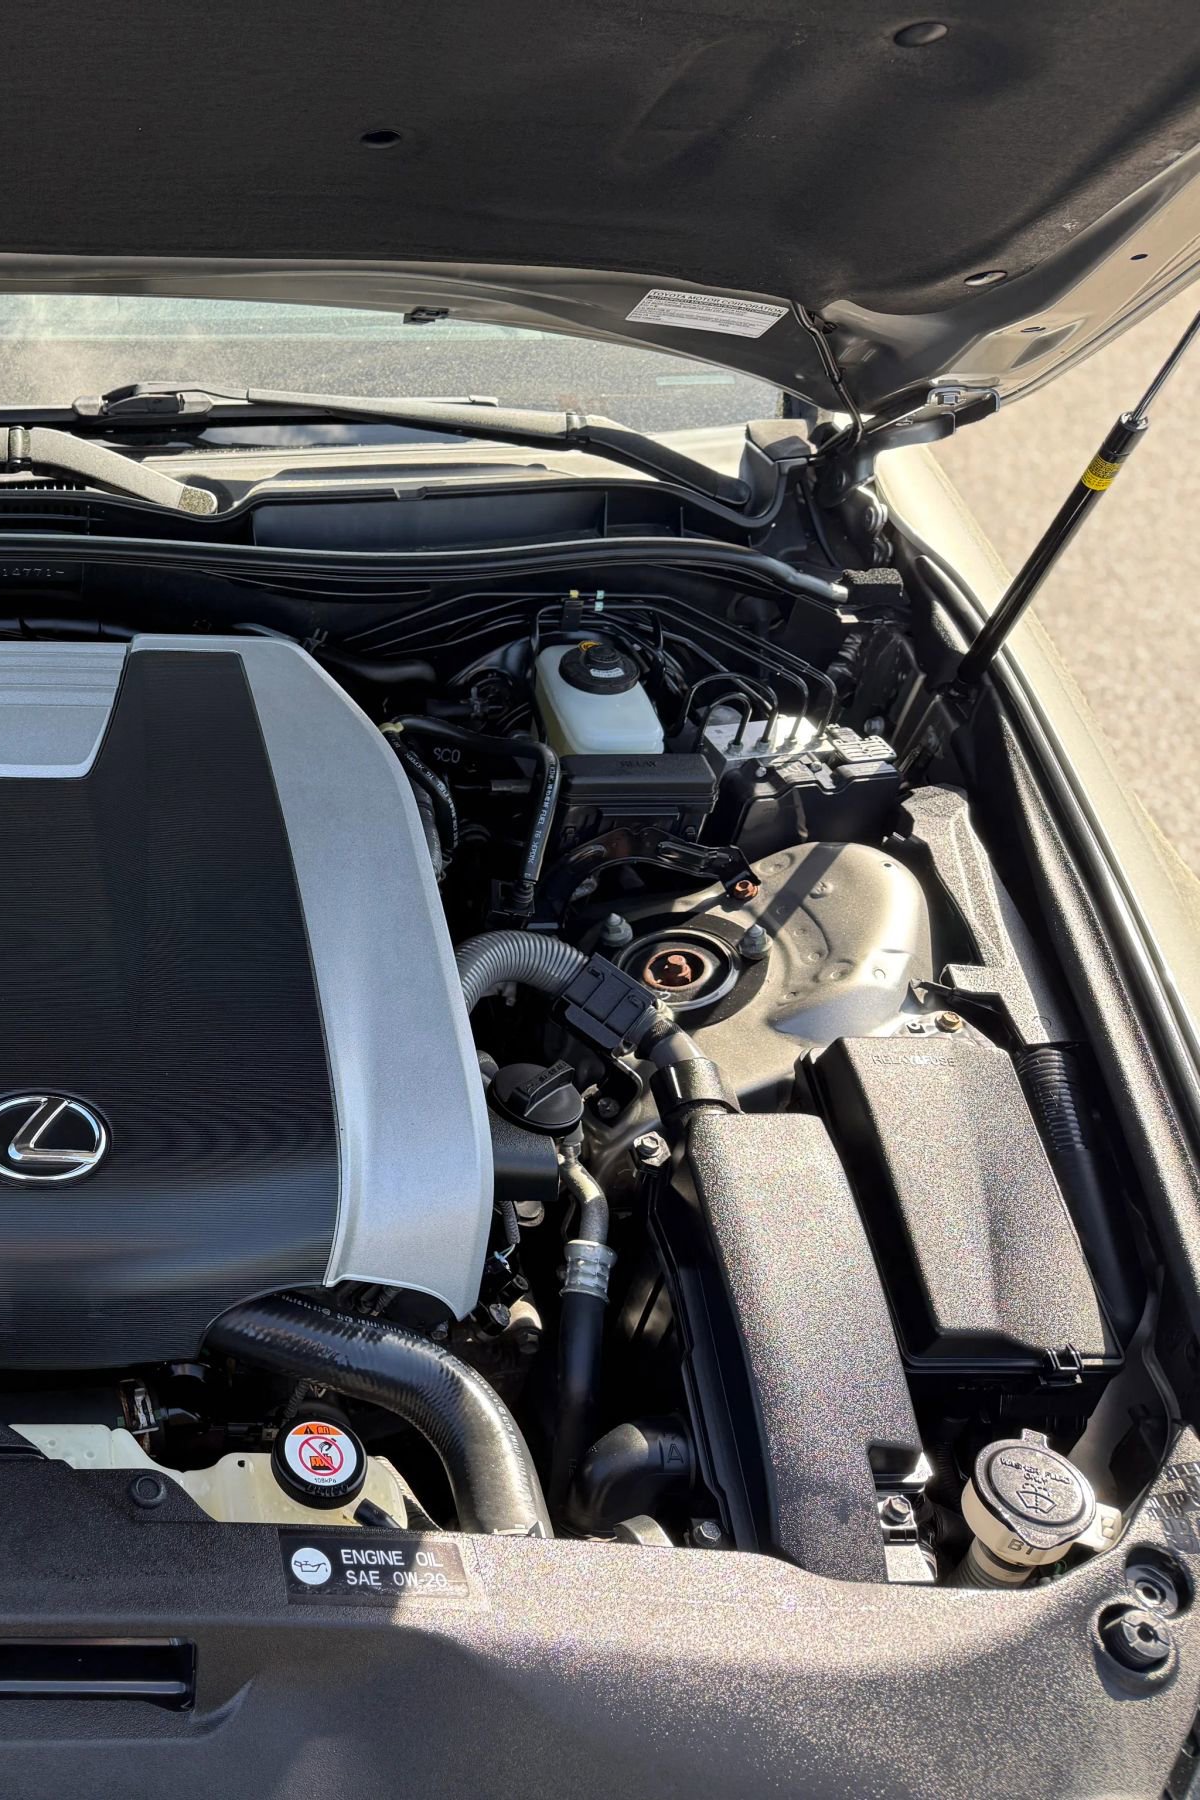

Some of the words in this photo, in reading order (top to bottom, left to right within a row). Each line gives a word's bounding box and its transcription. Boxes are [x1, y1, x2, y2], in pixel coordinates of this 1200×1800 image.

[652, 291, 687, 300] TOYOTA
[688, 294, 721, 304] MOTOR
[721, 298, 785, 314] CORPORATION
[667, 1443, 684, 1464] A
[340, 1548, 405, 1567] ENGINE
[415, 1550, 444, 1568] OIL
[345, 1569, 382, 1586] SAE
[393, 1570, 449, 1588] 0W-20
